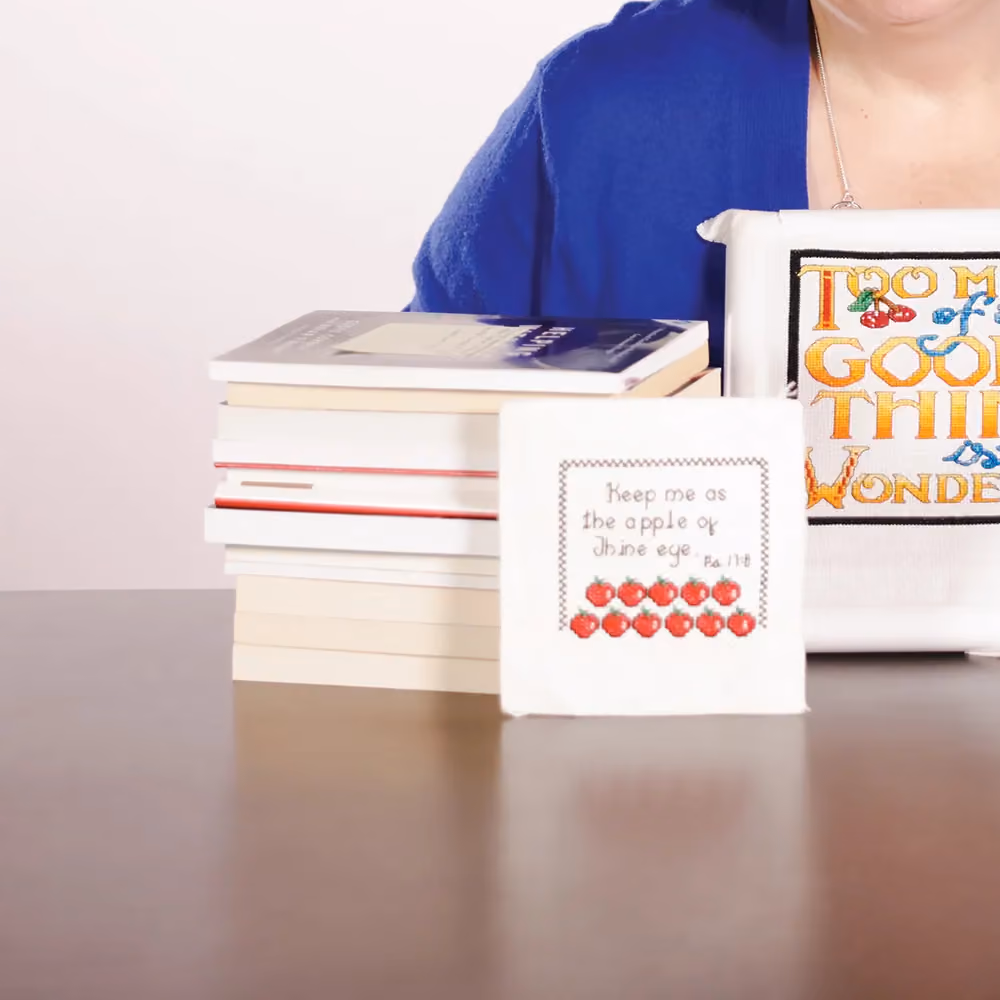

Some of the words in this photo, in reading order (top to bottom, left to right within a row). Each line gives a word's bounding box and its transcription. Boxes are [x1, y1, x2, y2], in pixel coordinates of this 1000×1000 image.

[796, 263, 937, 331] TOO
[916, 291, 996, 357] of
[606, 482, 656, 509] Keep
[665, 488, 696, 501] me
[705, 488, 727, 501] as
[583, 509, 616, 529] the
[625, 510, 688, 536] apple
[697, 516, 718, 536] of
